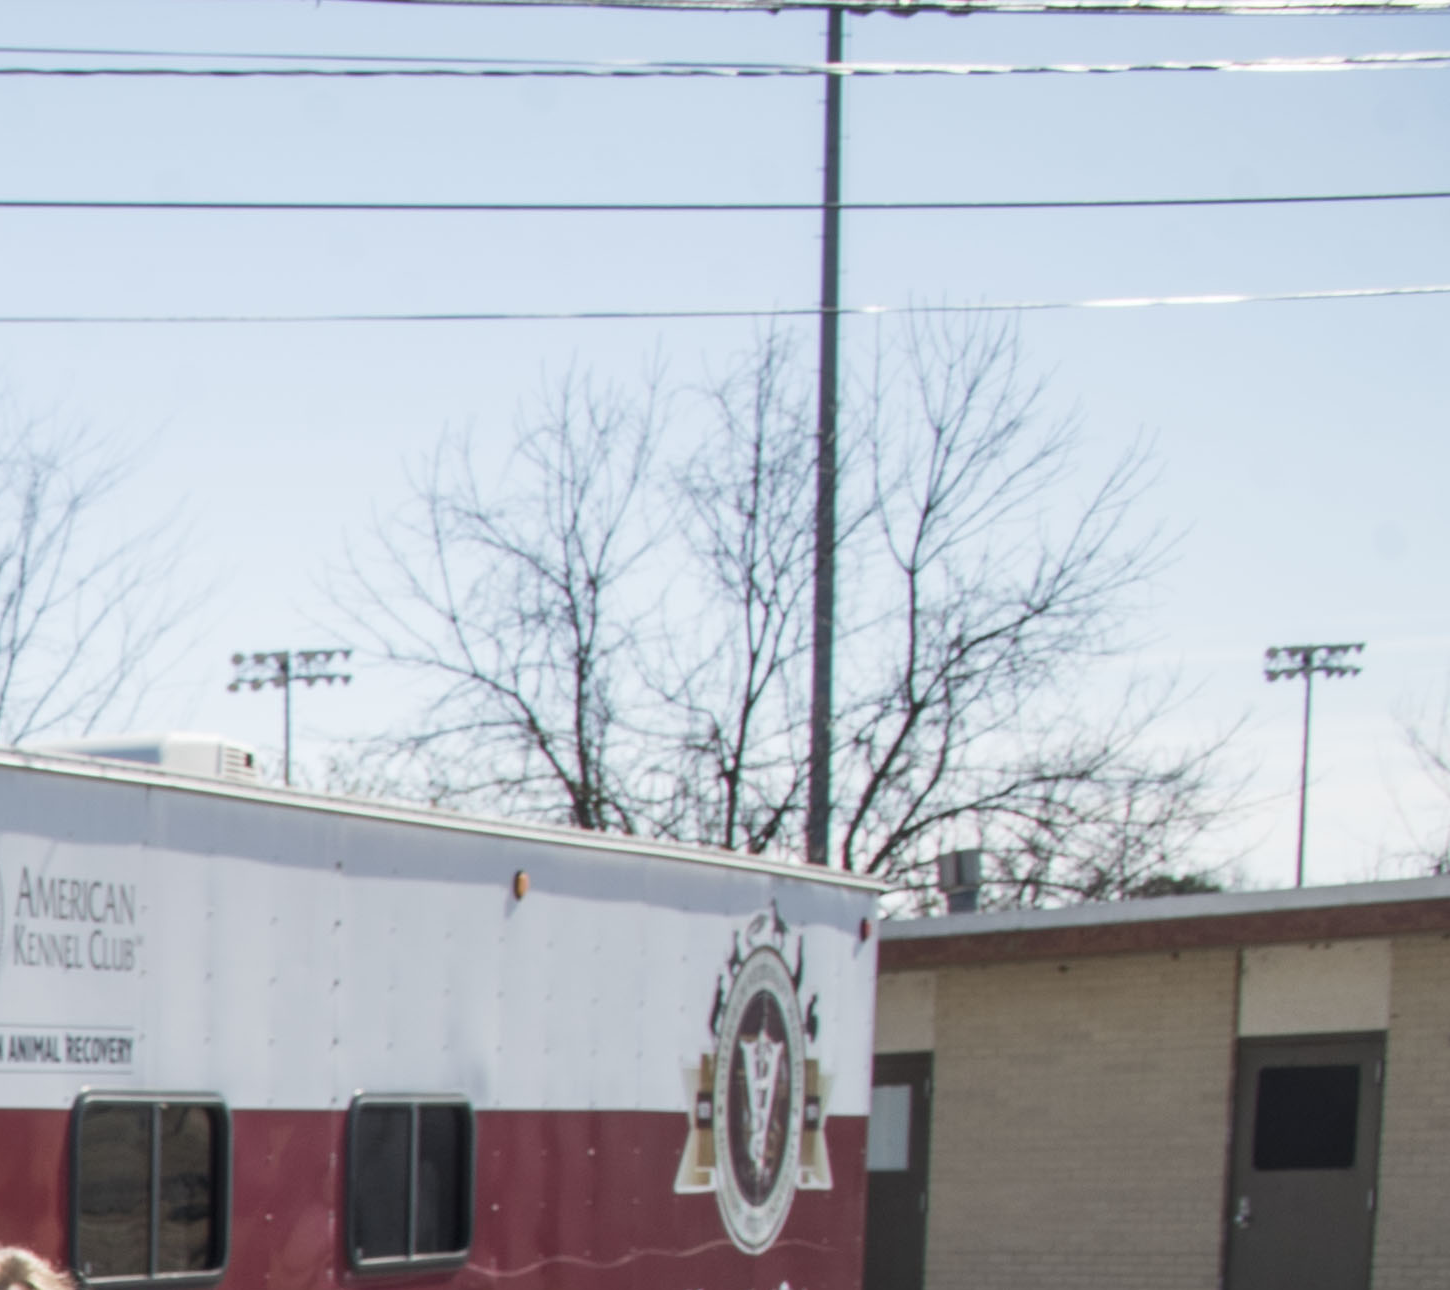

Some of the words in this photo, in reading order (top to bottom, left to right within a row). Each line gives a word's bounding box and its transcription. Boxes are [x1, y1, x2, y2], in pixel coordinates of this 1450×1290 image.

[14, 865, 136, 925] AMERICAN
[13, 923, 84, 971] KENNEL
[7, 1034, 62, 1063] ANIMAL
[65, 1031, 135, 1065] RECOVERY
